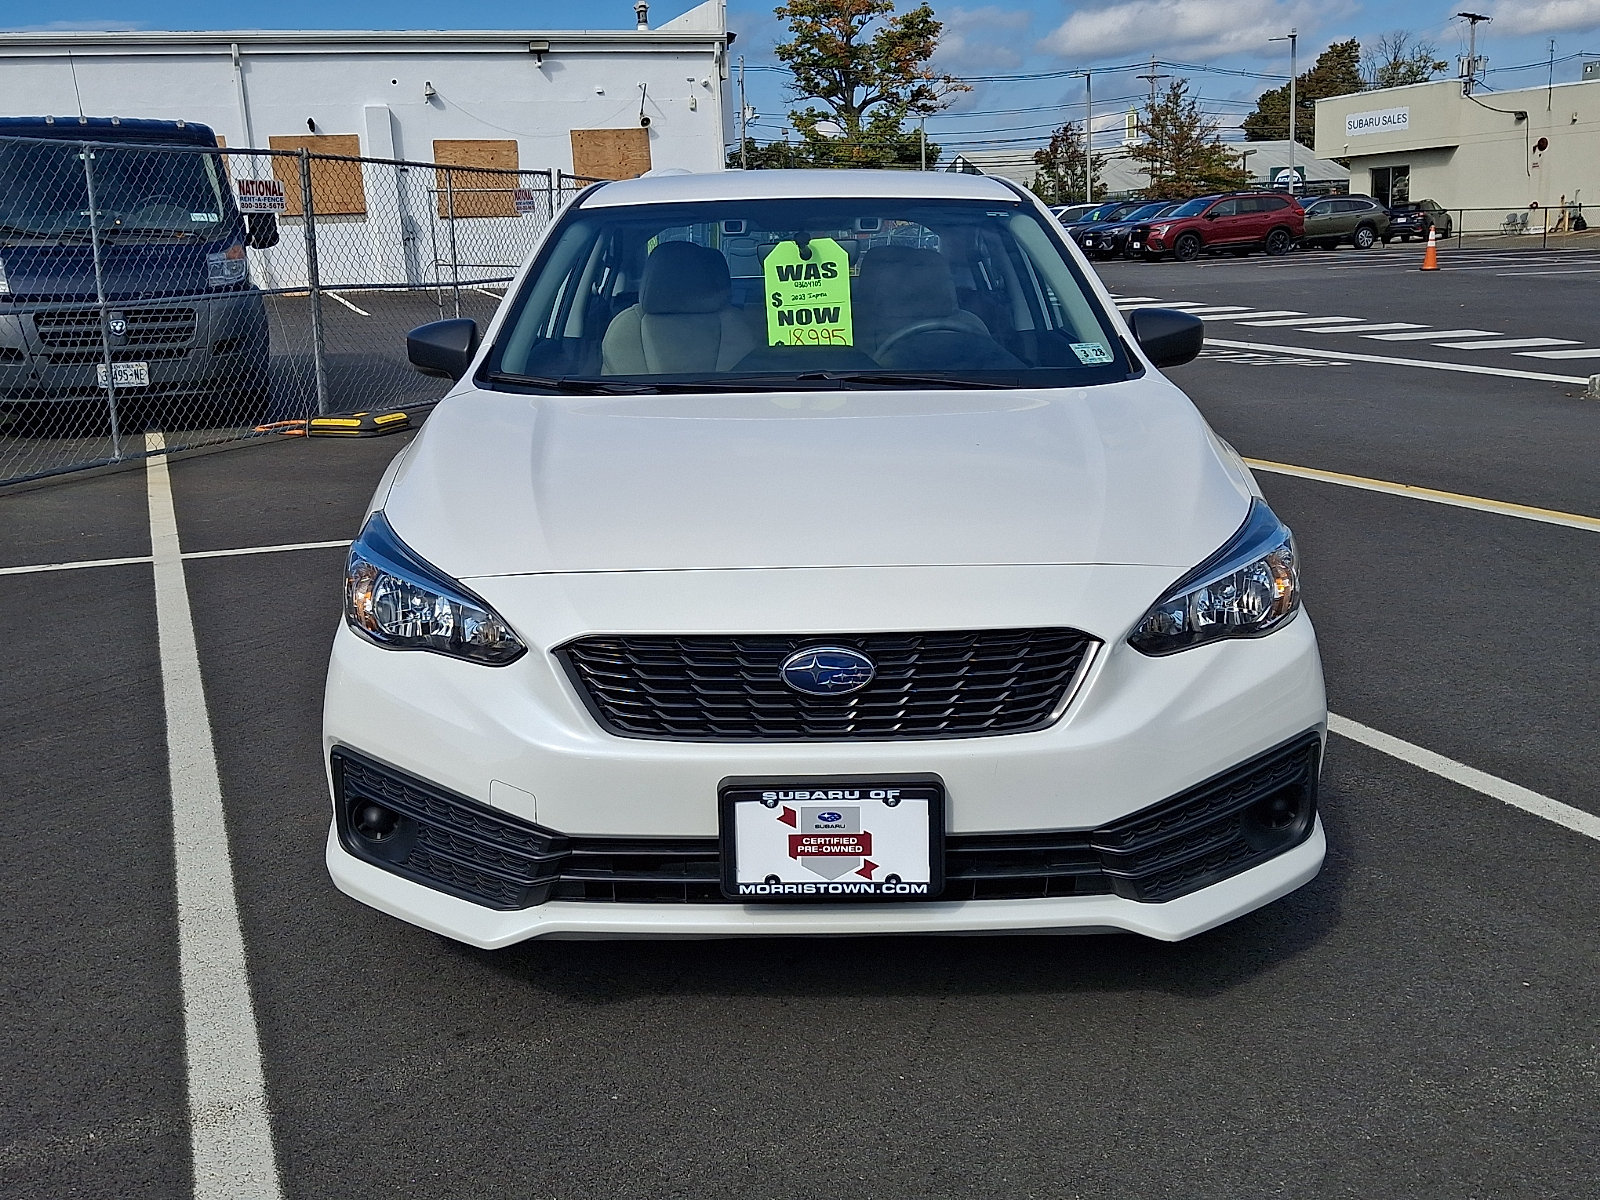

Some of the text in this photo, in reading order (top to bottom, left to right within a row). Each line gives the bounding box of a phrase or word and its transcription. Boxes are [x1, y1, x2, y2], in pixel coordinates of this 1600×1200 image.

[1347, 113, 1408, 130] SUBARU SALES
[239, 180, 283, 196] NATIONAL
[776, 262, 838, 281] WAS
[771, 291, 783, 308] $
[777, 306, 841, 327] NOW
[789, 328, 847, 346] 18995
[762, 789, 901, 801] SUBARU OF
[802, 837, 858, 845] CERTIFIED
[797, 845, 863, 854] PRE-OWNED
[739, 883, 928, 895] MORRISTOWN.COM
